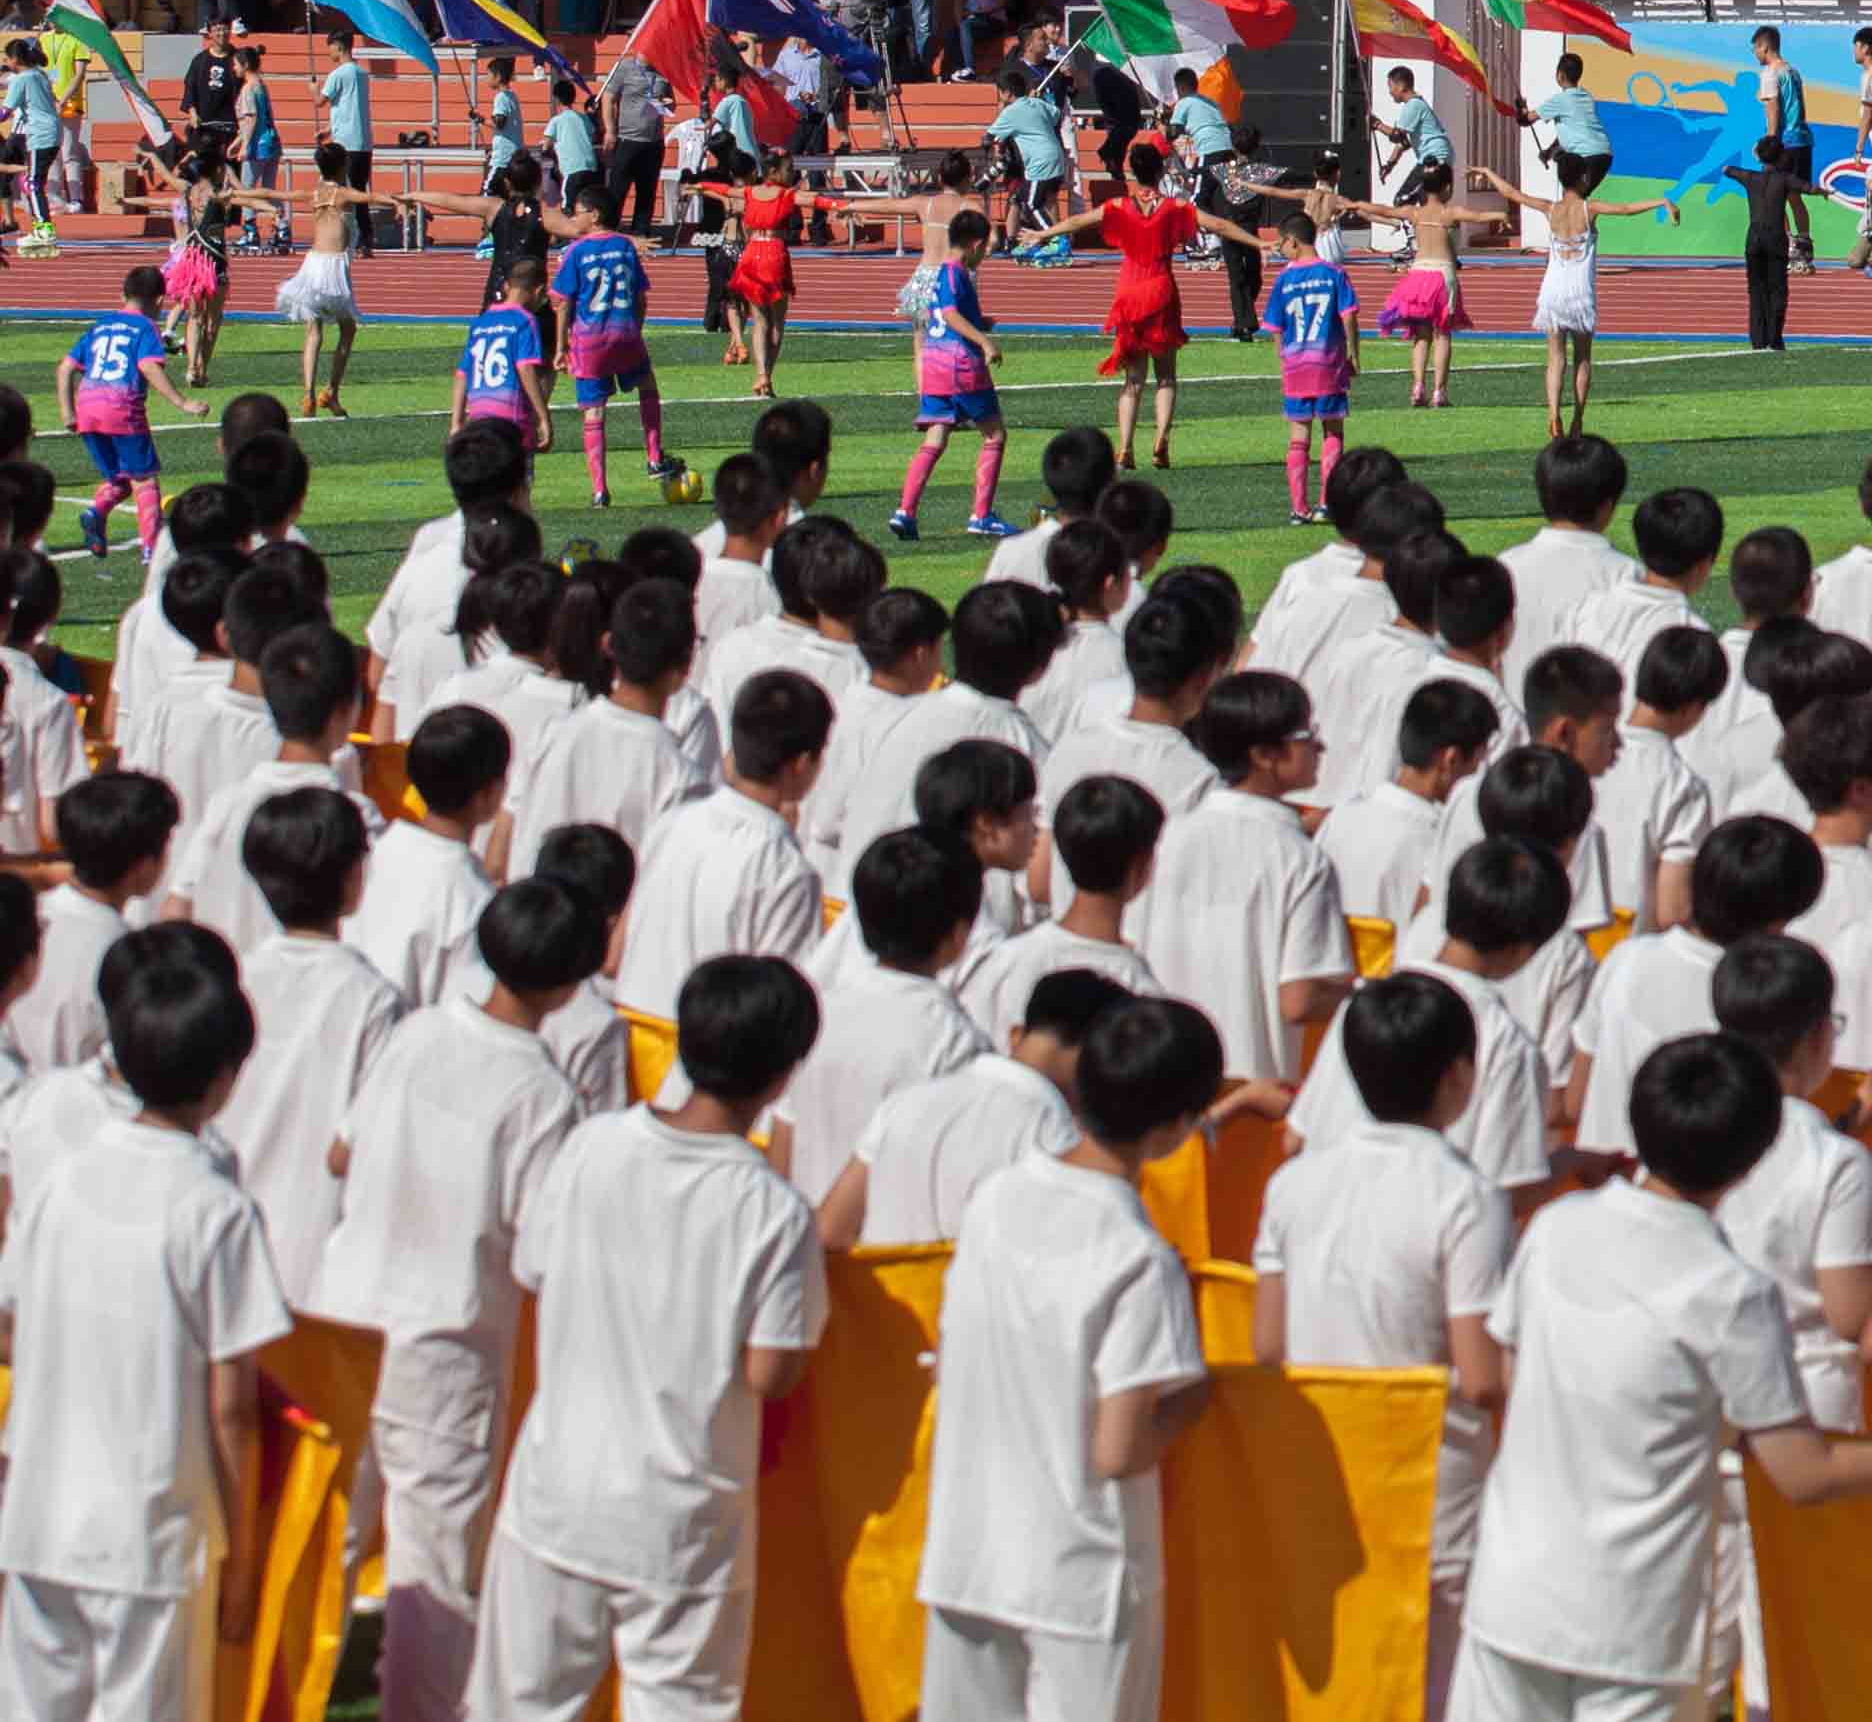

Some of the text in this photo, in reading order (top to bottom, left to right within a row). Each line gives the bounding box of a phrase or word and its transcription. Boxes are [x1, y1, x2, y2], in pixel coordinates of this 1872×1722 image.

[586, 262, 633, 313] 23
[1285, 293, 1331, 343] 17
[89, 333, 131, 383] 15
[469, 335, 510, 390] 16
